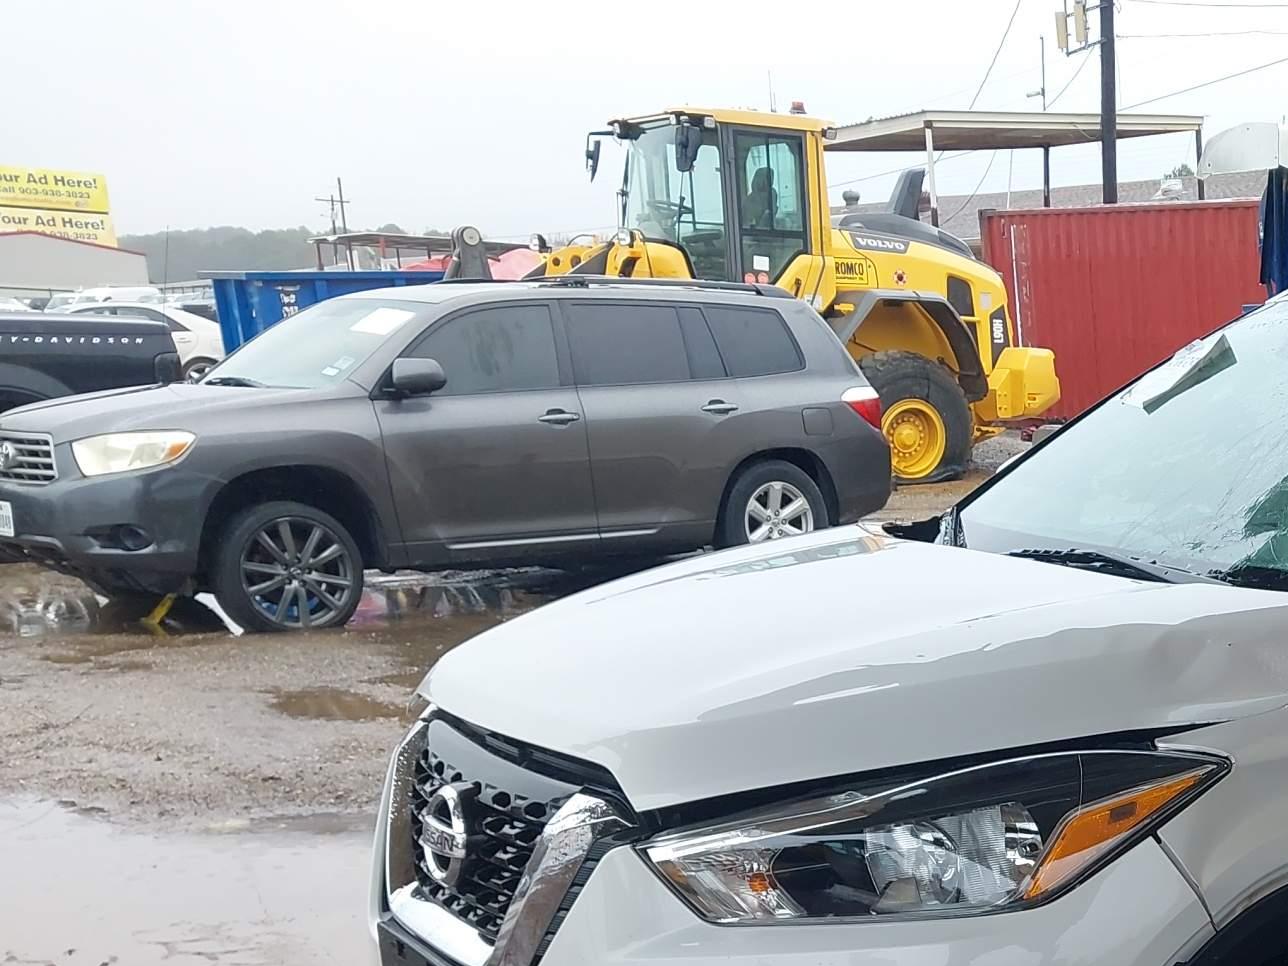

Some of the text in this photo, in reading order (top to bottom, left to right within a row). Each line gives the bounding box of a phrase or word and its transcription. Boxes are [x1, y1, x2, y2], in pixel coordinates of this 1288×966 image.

[27, 173, 48, 185] Ad
[53, 175, 97, 189] Here!
[35, 215, 56, 227] Ad
[61, 217, 105, 230] Here!
[855, 237, 905, 250] VOLVO
[835, 261, 864, 276] ROMCO
[992, 319, 1004, 343] L90H
[0, 335, 144, 345] Y-DAVIDSON
